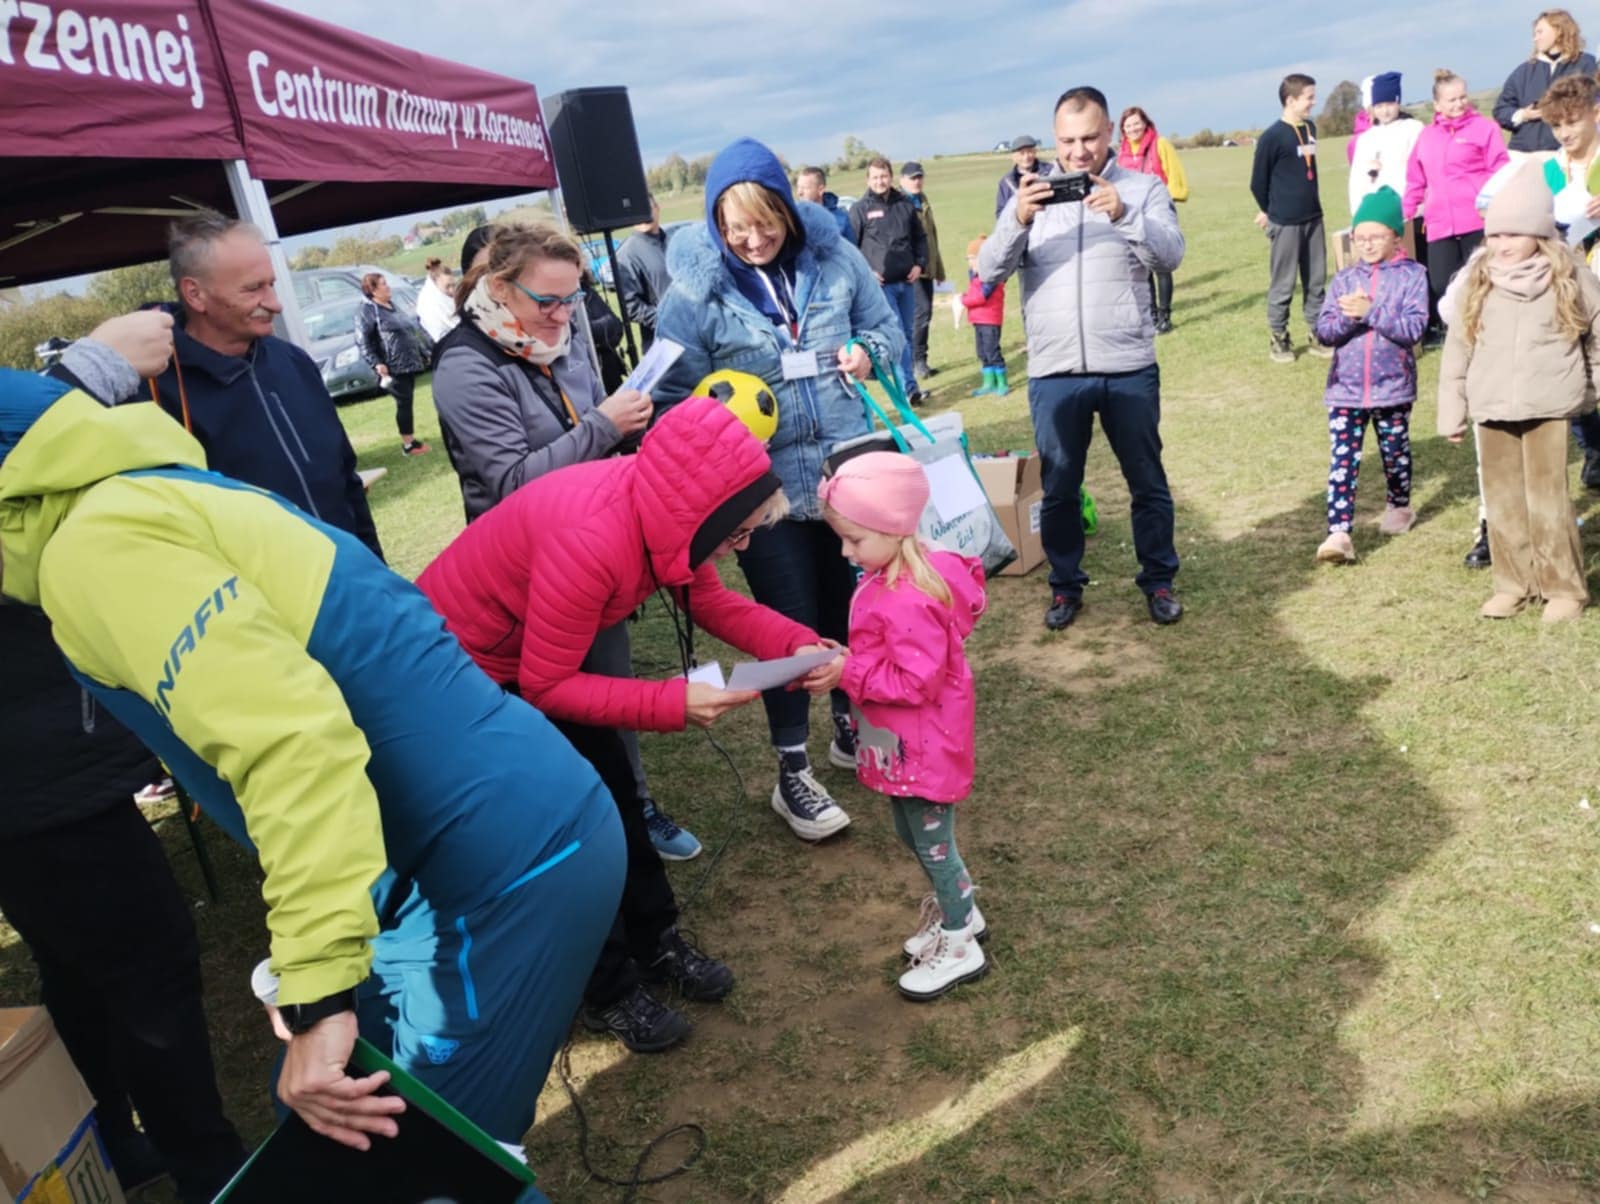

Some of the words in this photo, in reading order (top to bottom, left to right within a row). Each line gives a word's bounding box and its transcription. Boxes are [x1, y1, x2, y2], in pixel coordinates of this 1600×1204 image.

[248, 50, 382, 129] Centrum
[460, 103, 477, 140] w
[476, 103, 549, 162] Korzennej
[154, 575, 239, 729] NAFIT
